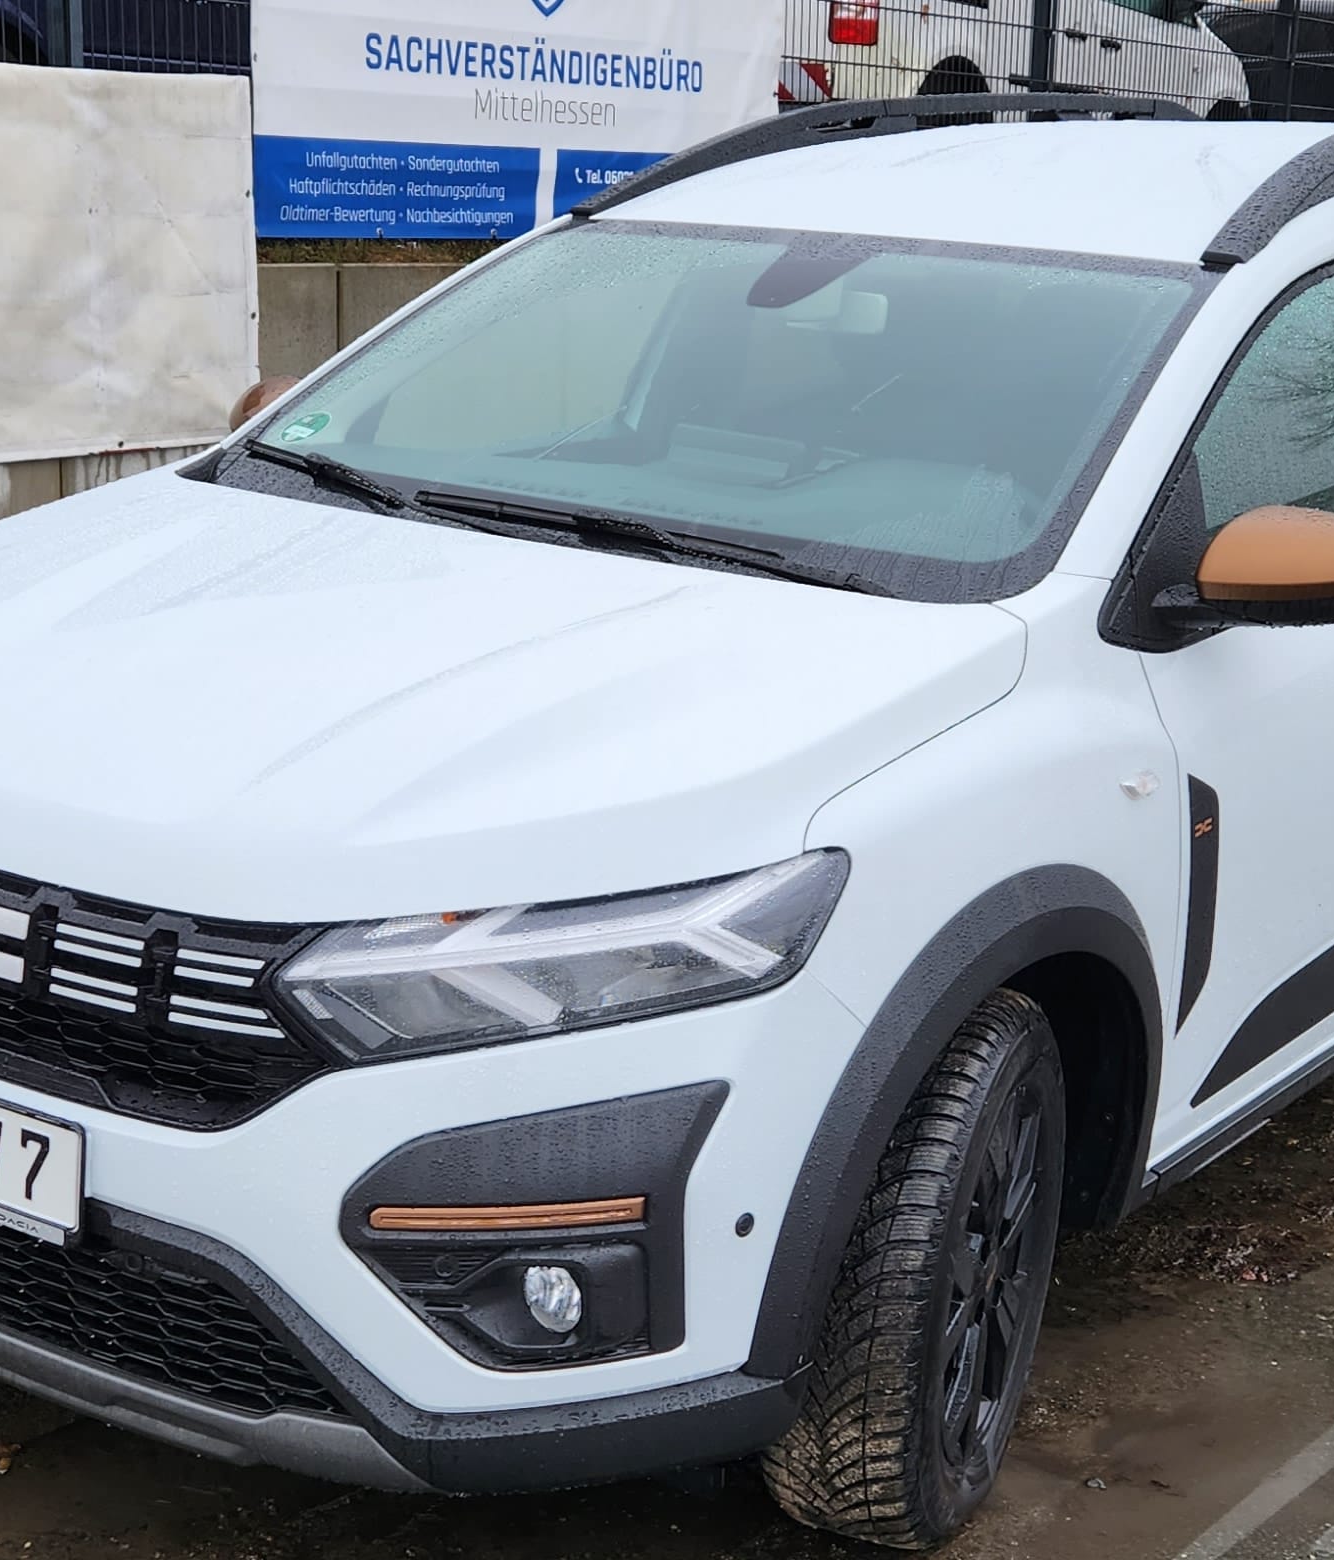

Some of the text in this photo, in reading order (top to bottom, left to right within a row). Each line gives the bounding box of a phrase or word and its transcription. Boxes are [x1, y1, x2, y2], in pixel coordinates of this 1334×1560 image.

[365, 32, 703, 93] SACHVERSTÄNDIGENBÜRO
[474, 87, 616, 128] Mittelhessen
[306, 151, 500, 174] Unfallgutachten Sondergutachten
[585, 169, 603, 184] Tel.
[289, 177, 506, 202] Haftpflichtschäden Rechnungsprüfung
[280, 204, 514, 227] Oldtimer-Bewertung Nachbesichtigungen
[21, 1129, 50, 1201] 7
